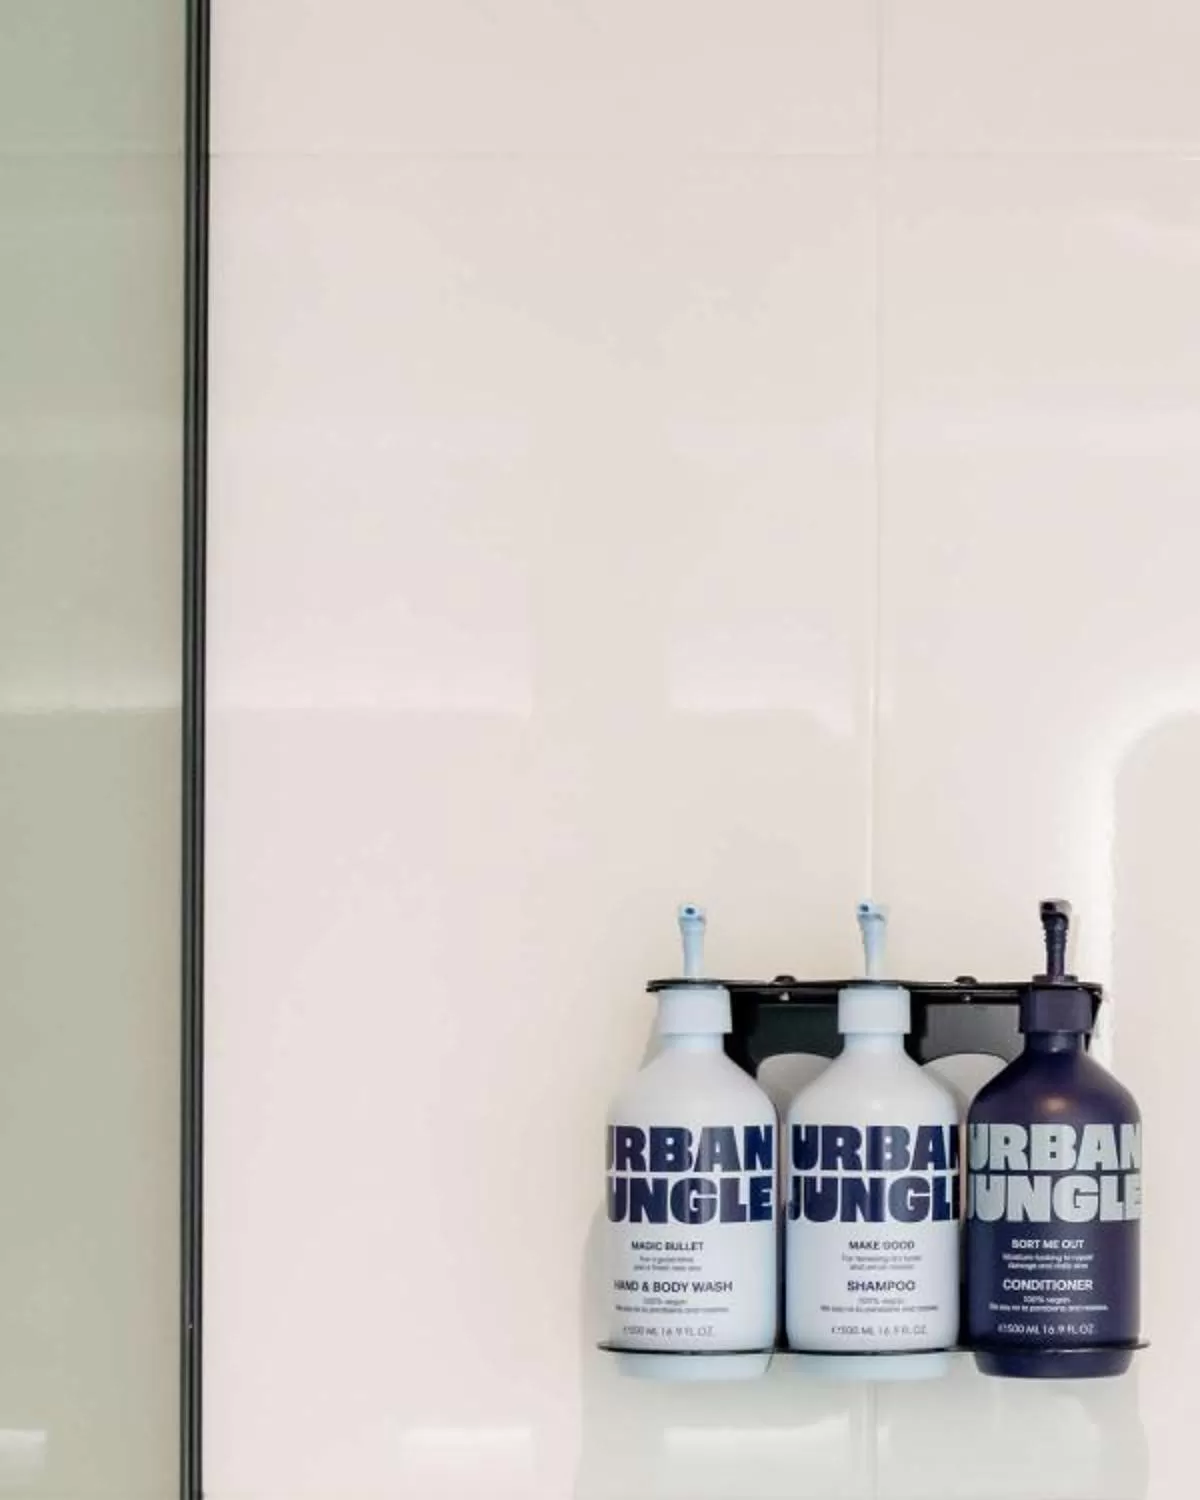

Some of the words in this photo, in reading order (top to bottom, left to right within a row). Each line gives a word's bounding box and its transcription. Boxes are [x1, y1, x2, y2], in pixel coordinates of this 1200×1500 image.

[608, 1176, 773, 1224] UNGLE
[631, 1241, 663, 1251] MAGIC
[664, 1241, 704, 1251] BULLET
[848, 1240, 880, 1250] MAKE
[882, 1240, 915, 1250] GOOD
[1042, 1239, 1060, 1249] ME
[1061, 1239, 1085, 1249] OUT
[613, 1279, 639, 1291] HAND
[641, 1281, 649, 1292] &
[652, 1281, 688, 1292] BODY
[691, 1281, 733, 1292] WASH
[847, 1279, 916, 1292] SHAMPOO
[1003, 1278, 1093, 1291] CONDITIONER
